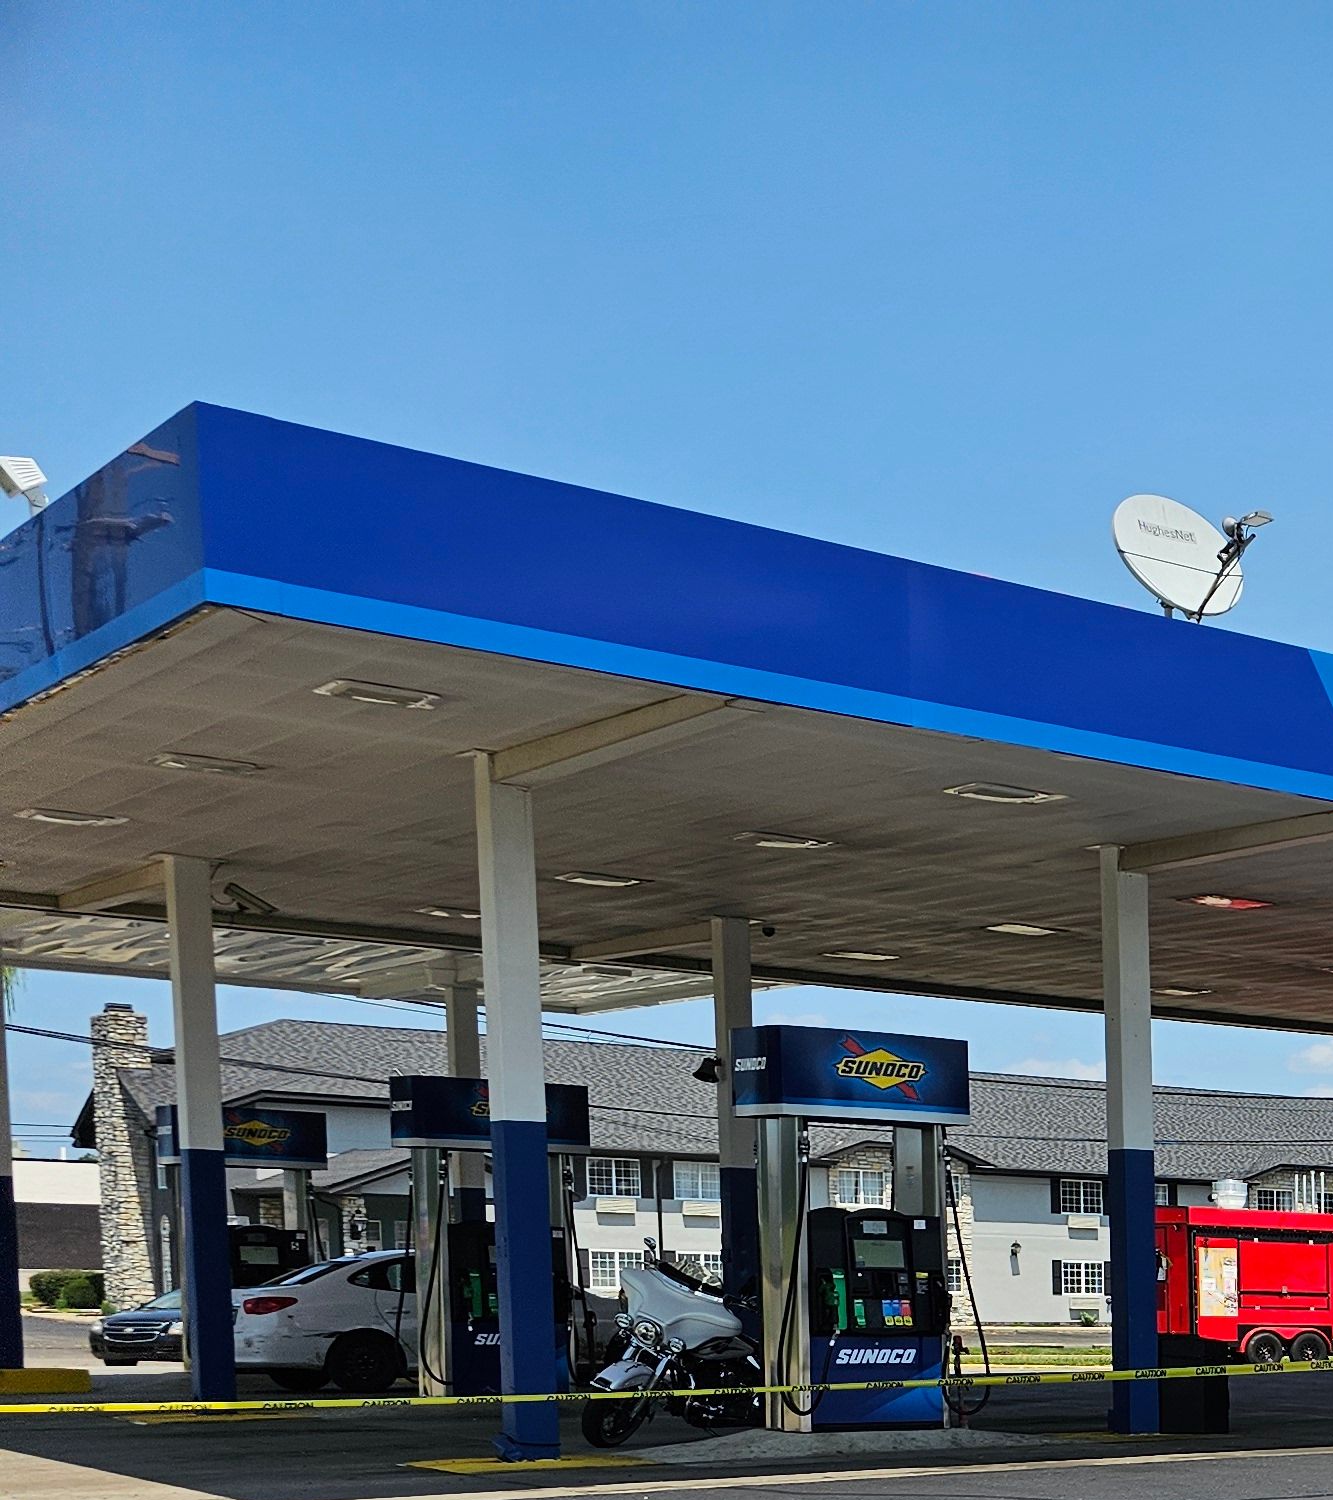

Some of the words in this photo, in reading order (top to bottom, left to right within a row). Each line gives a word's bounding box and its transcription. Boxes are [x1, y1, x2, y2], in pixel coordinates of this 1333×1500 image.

[1137, 519, 1196, 544] HughesNet
[735, 1057, 767, 1072] SUNOCO
[840, 1059, 920, 1080] SUNOCO
[224, 1126, 289, 1140] SUNOCO
[835, 1348, 917, 1365] SUNOCO
[1006, 1376, 1041, 1385] CAUTION
[1072, 1372, 1105, 1381] CAUTION
[1135, 1369, 1167, 1378] CAUTION
[1196, 1366, 1227, 1375] CAUTION
[1254, 1363, 1284, 1373] CAUTION
